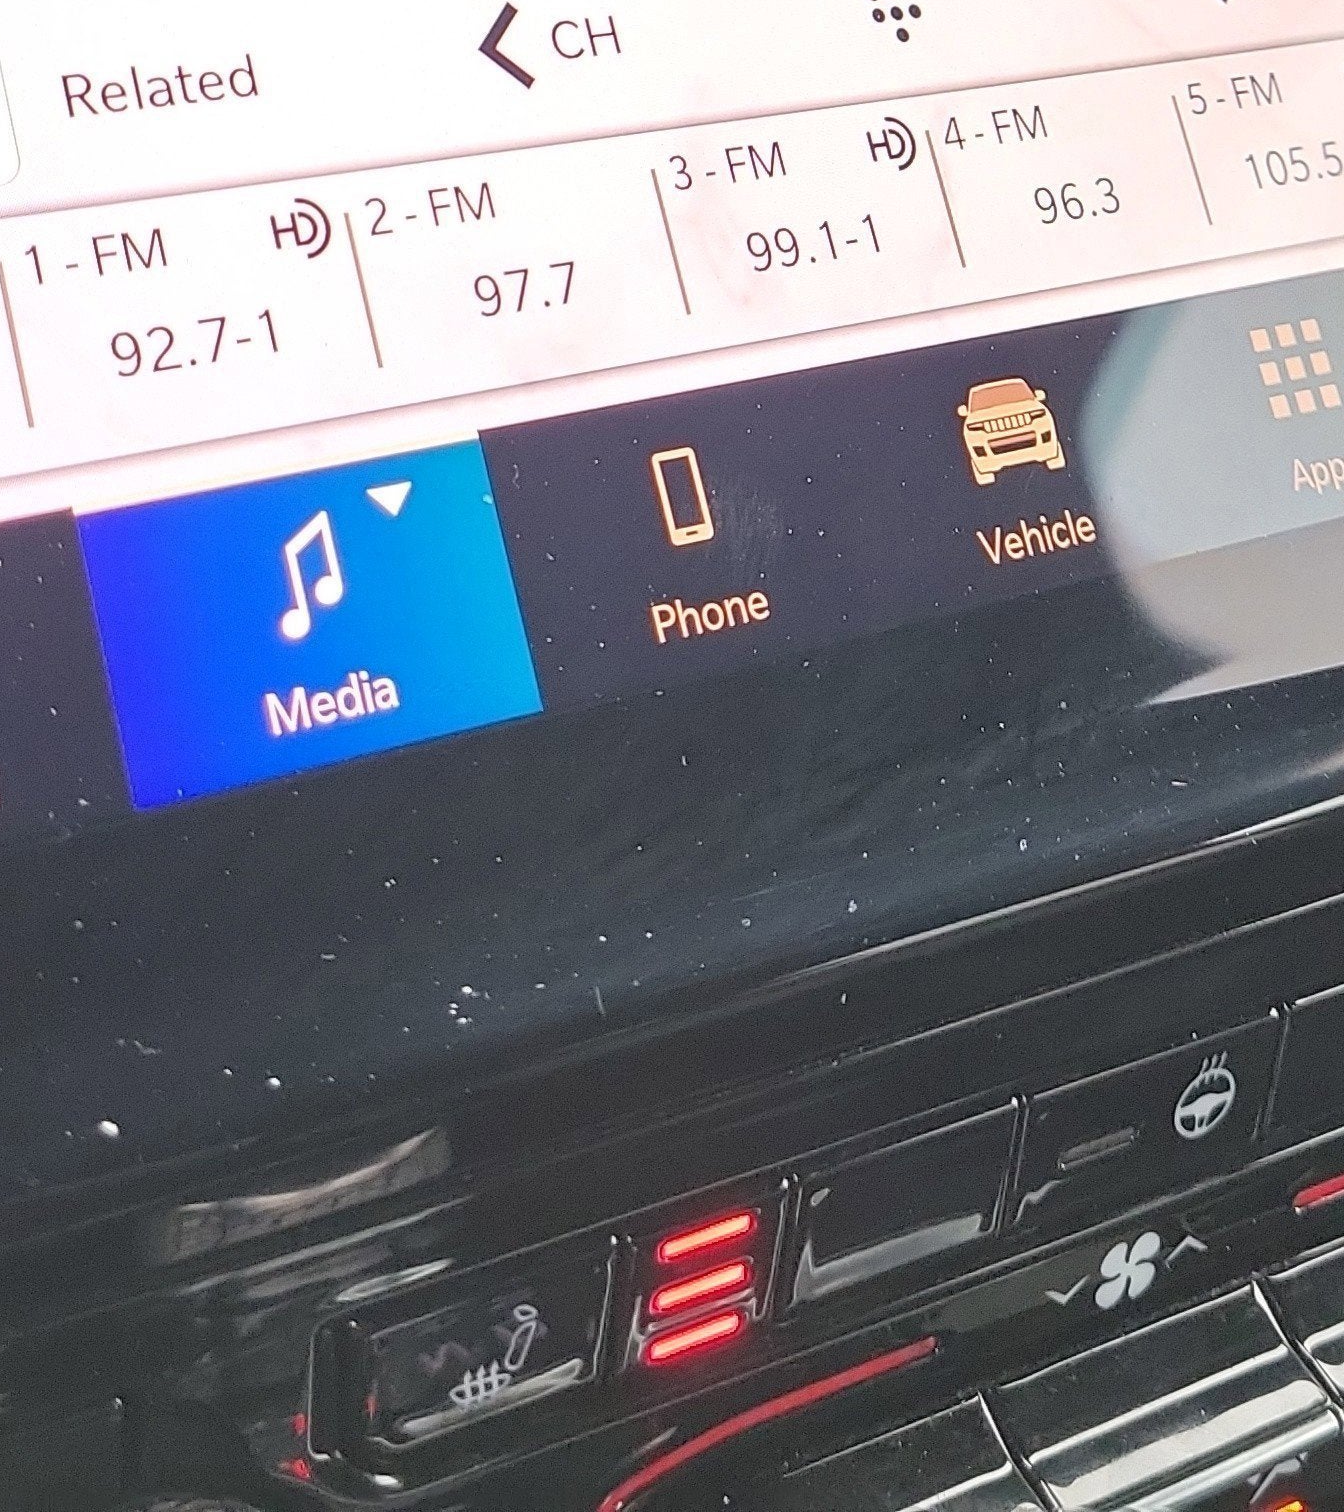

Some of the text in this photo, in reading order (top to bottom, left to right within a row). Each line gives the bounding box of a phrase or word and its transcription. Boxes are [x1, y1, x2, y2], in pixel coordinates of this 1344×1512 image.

[551, 15, 623, 60] CH
[61, 53, 260, 118] Related
[1033, 176, 1122, 225] 96.3
[746, 213, 882, 273] 99.1-1
[473, 261, 577, 319] 97.7
[110, 308, 282, 378] 92.7-1
[975, 509, 1098, 567] Vehicle
[650, 586, 771, 645] Phone
[262, 670, 401, 738] Media
